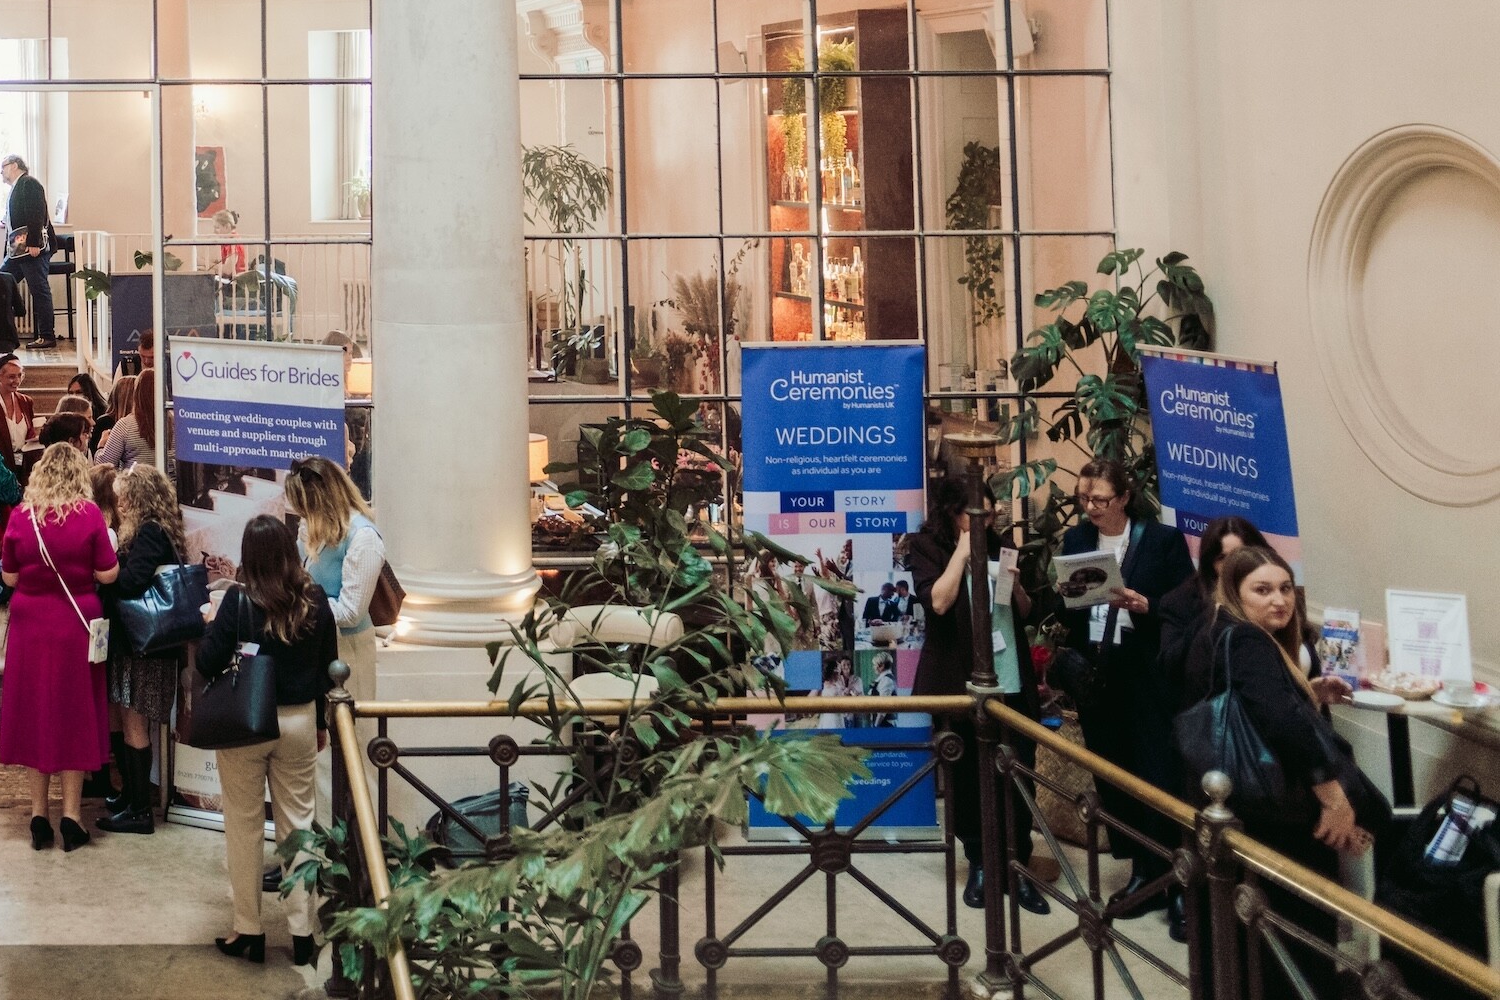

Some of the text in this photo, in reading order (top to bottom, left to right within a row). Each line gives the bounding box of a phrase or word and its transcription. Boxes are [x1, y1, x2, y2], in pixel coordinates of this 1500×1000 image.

[201, 361, 340, 387] Guides for Brides
[791, 369, 864, 385] Humanist
[770, 378, 895, 401] Ceremonies
[1175, 383, 1231, 407] Humanist
[178, 408, 337, 431] Connecting wedding couples with
[1160, 390, 1255, 429] Ceremonies
[187, 426, 327, 447] venues and suppliers through
[775, 425, 896, 445] WEDDINGS
[193, 441, 268, 457] multi-approach
[765, 454, 908, 465] Non-religious, heartfelt ceremonies
[1167, 441, 1259, 479] WEDDINGS
[802, 467, 839, 475] individual
[850, 467, 866, 476] you
[790, 496, 886, 507] YOUR STORY
[1233, 487, 1271, 502] ceremonies
[778, 517, 898, 529] IS OUR STORY
